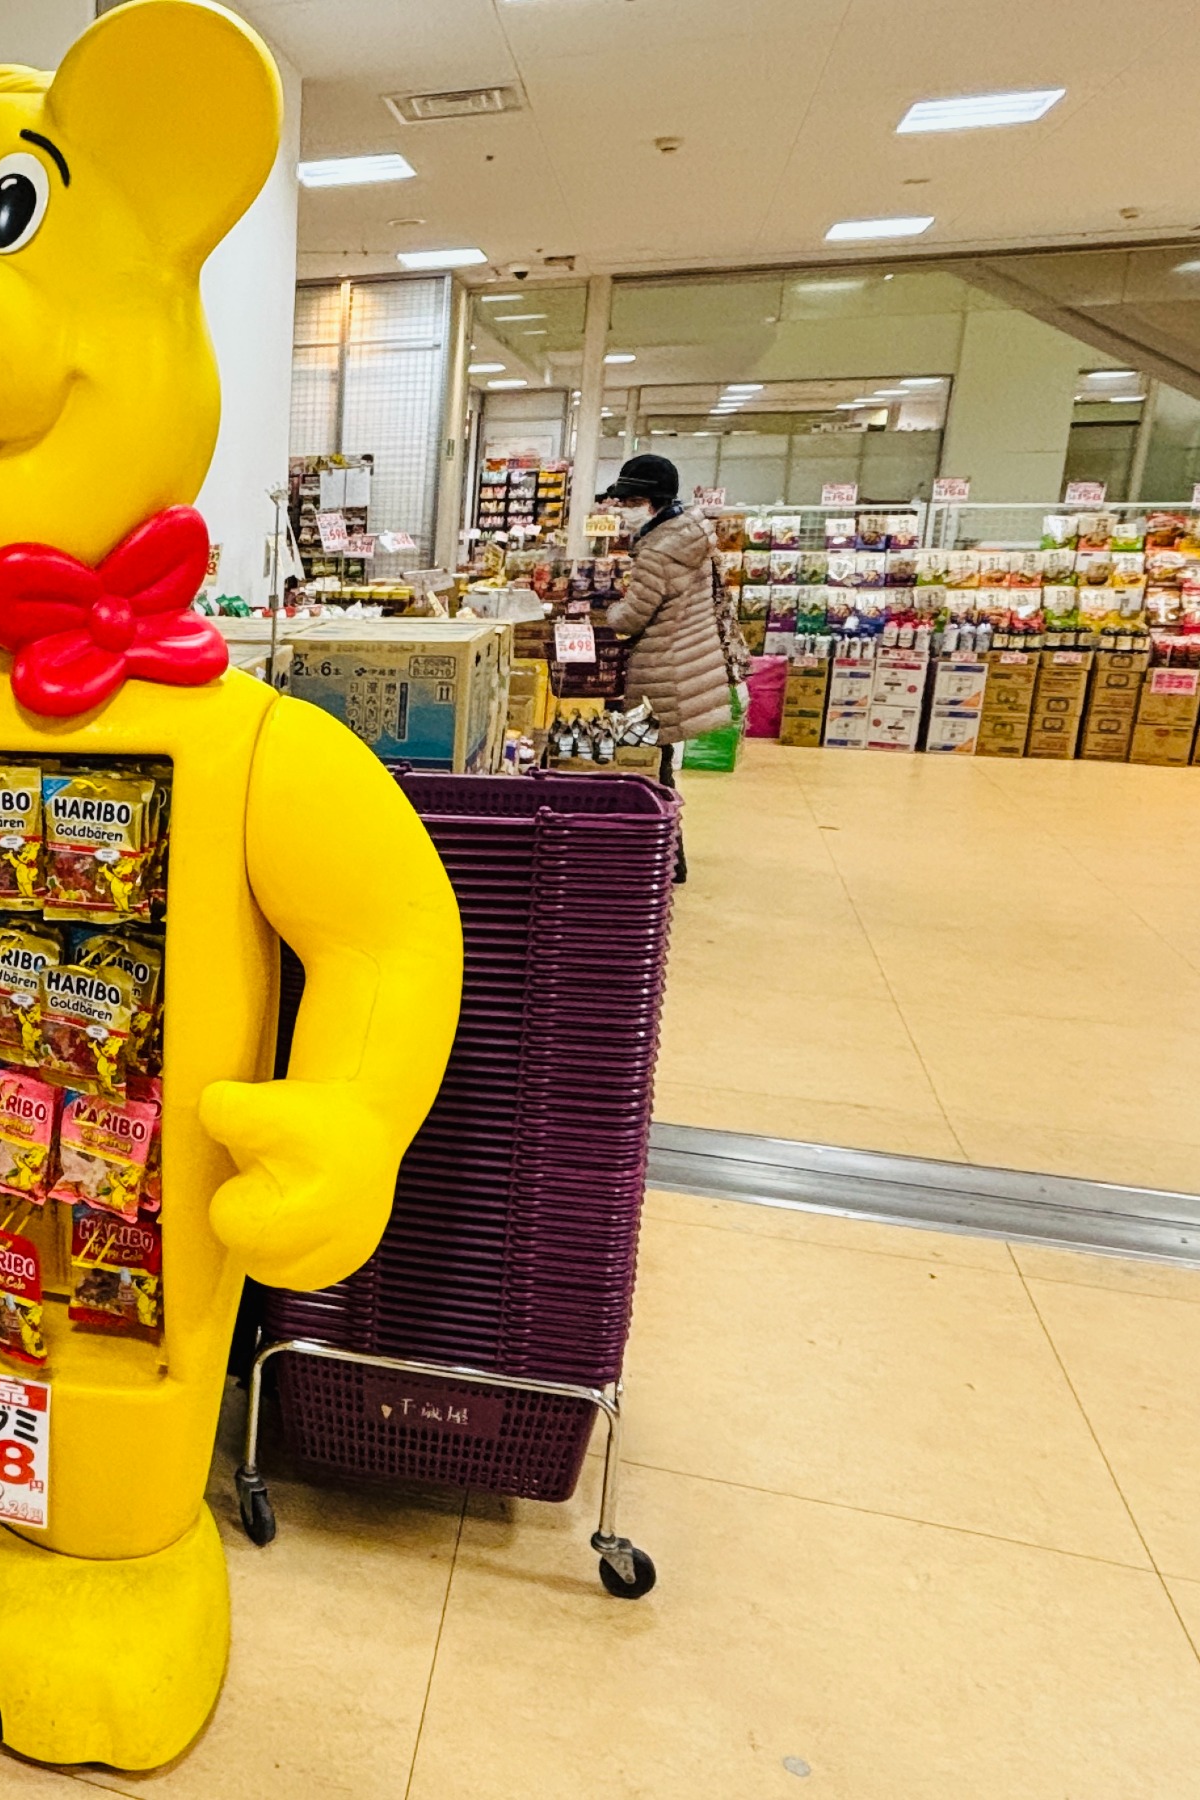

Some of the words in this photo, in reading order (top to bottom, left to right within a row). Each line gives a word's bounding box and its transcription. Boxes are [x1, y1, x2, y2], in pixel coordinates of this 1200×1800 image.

[54, 798, 131, 825] HARIBO
[55, 823, 123, 842] Goldbären
[46, 970, 120, 1005] HARIBO
[50, 996, 112, 1021] Goldbären
[79, 1218, 154, 1253] HARIBO
